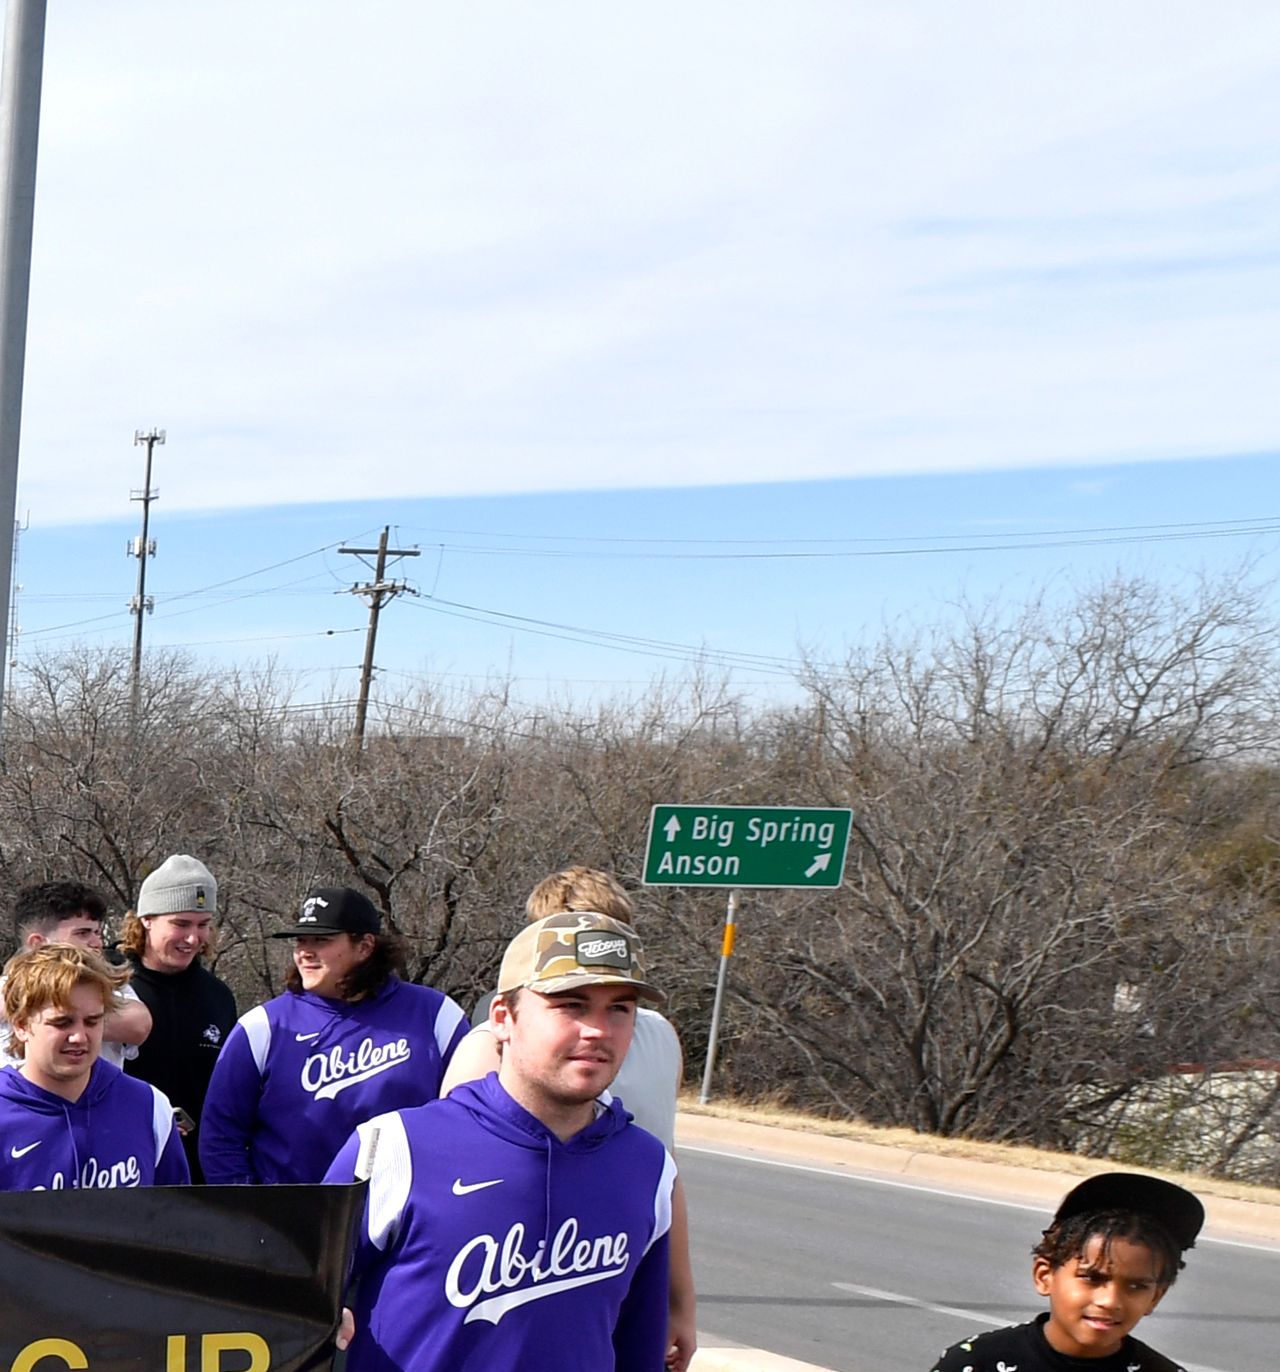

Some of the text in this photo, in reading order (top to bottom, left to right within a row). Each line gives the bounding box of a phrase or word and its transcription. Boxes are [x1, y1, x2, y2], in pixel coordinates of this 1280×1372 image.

[691, 814, 835, 849] Big Spring
[657, 851, 740, 876] Anson
[301, 1038, 410, 1092] Abilene
[445, 1217, 630, 1308] Abilene
